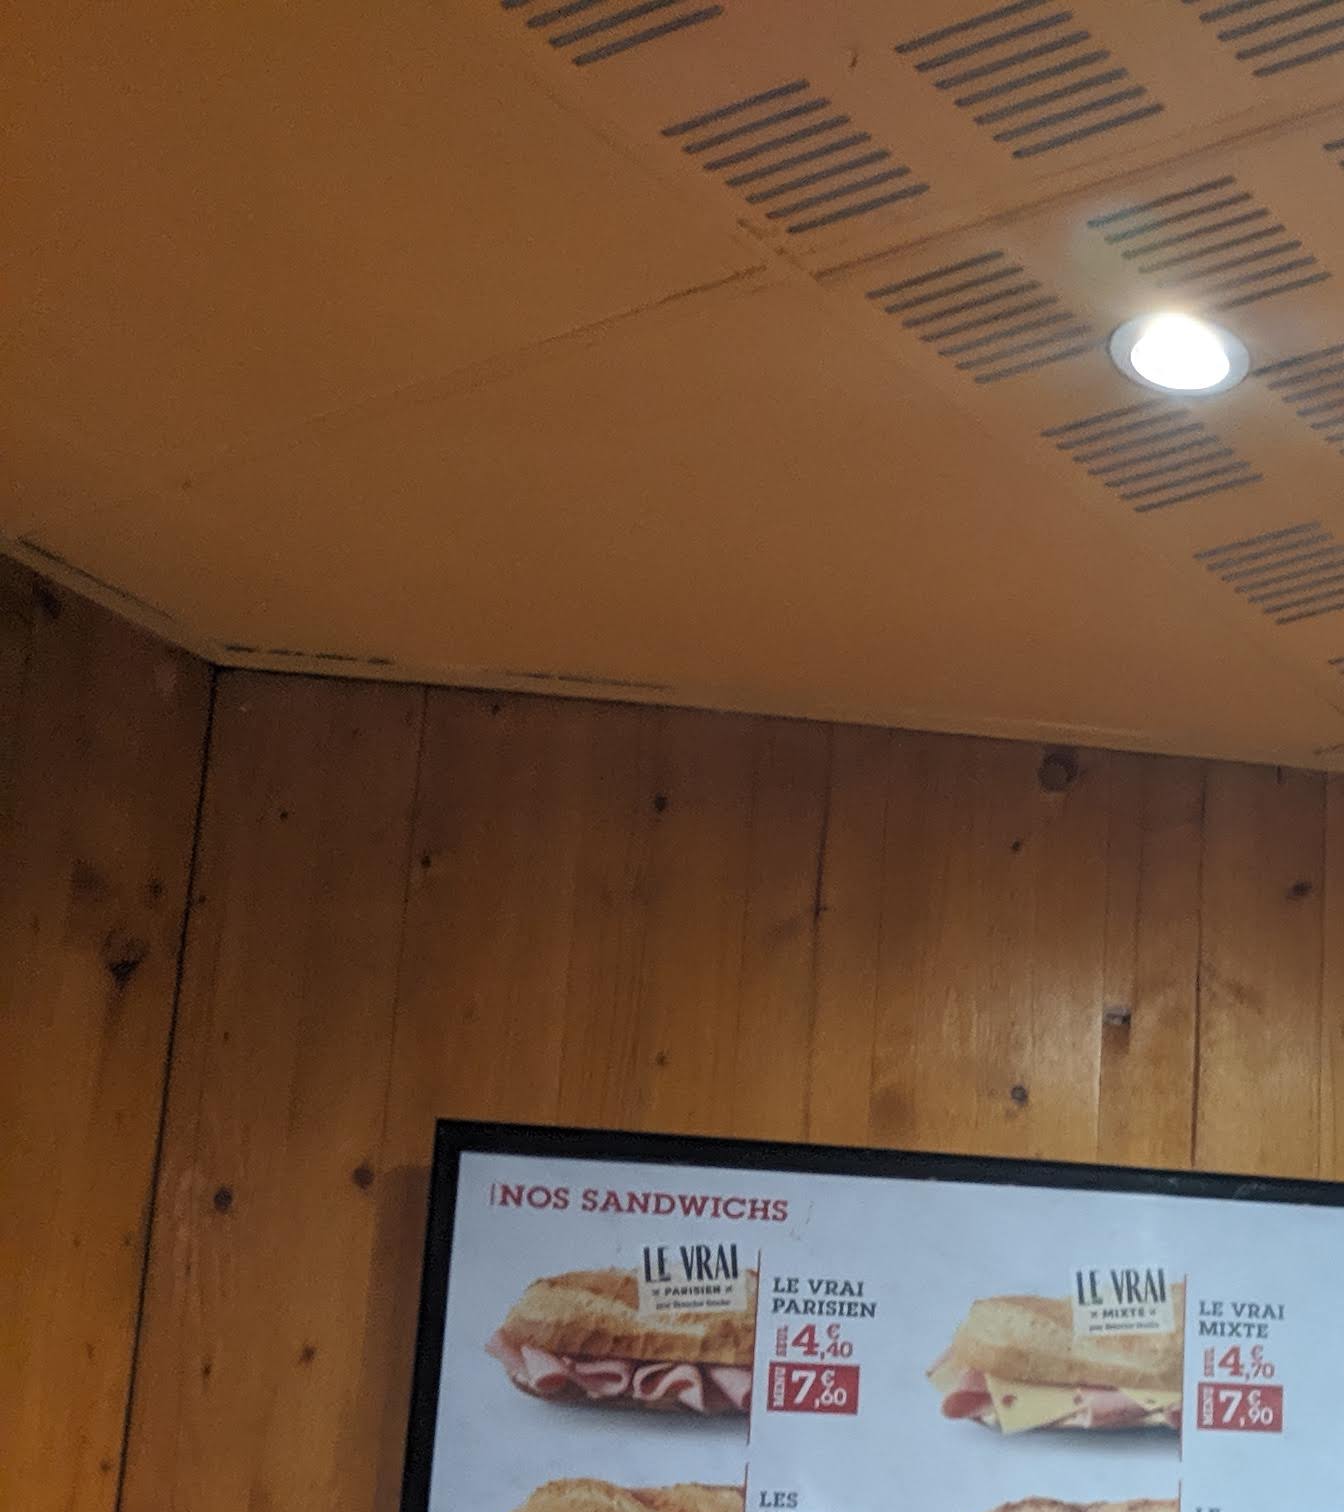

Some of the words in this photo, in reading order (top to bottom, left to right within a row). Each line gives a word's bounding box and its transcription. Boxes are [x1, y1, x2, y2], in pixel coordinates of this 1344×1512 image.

[500, 1184, 569, 1209] NOS
[581, 1188, 788, 1222] SANDWICHS
[643, 1246, 671, 1282] LE
[681, 1244, 739, 1280] VRAI
[773, 1278, 798, 1294] LE
[808, 1279, 864, 1297] VRAI
[1076, 1269, 1103, 1306] LE
[1111, 1268, 1166, 1304] VRAI
[772, 1299, 876, 1318] PARISIEN
[1199, 1301, 1223, 1316] LE
[1232, 1303, 1285, 1320] VRAI
[1199, 1321, 1268, 1338] MIXTE
[759, 1491, 798, 1508] LES
